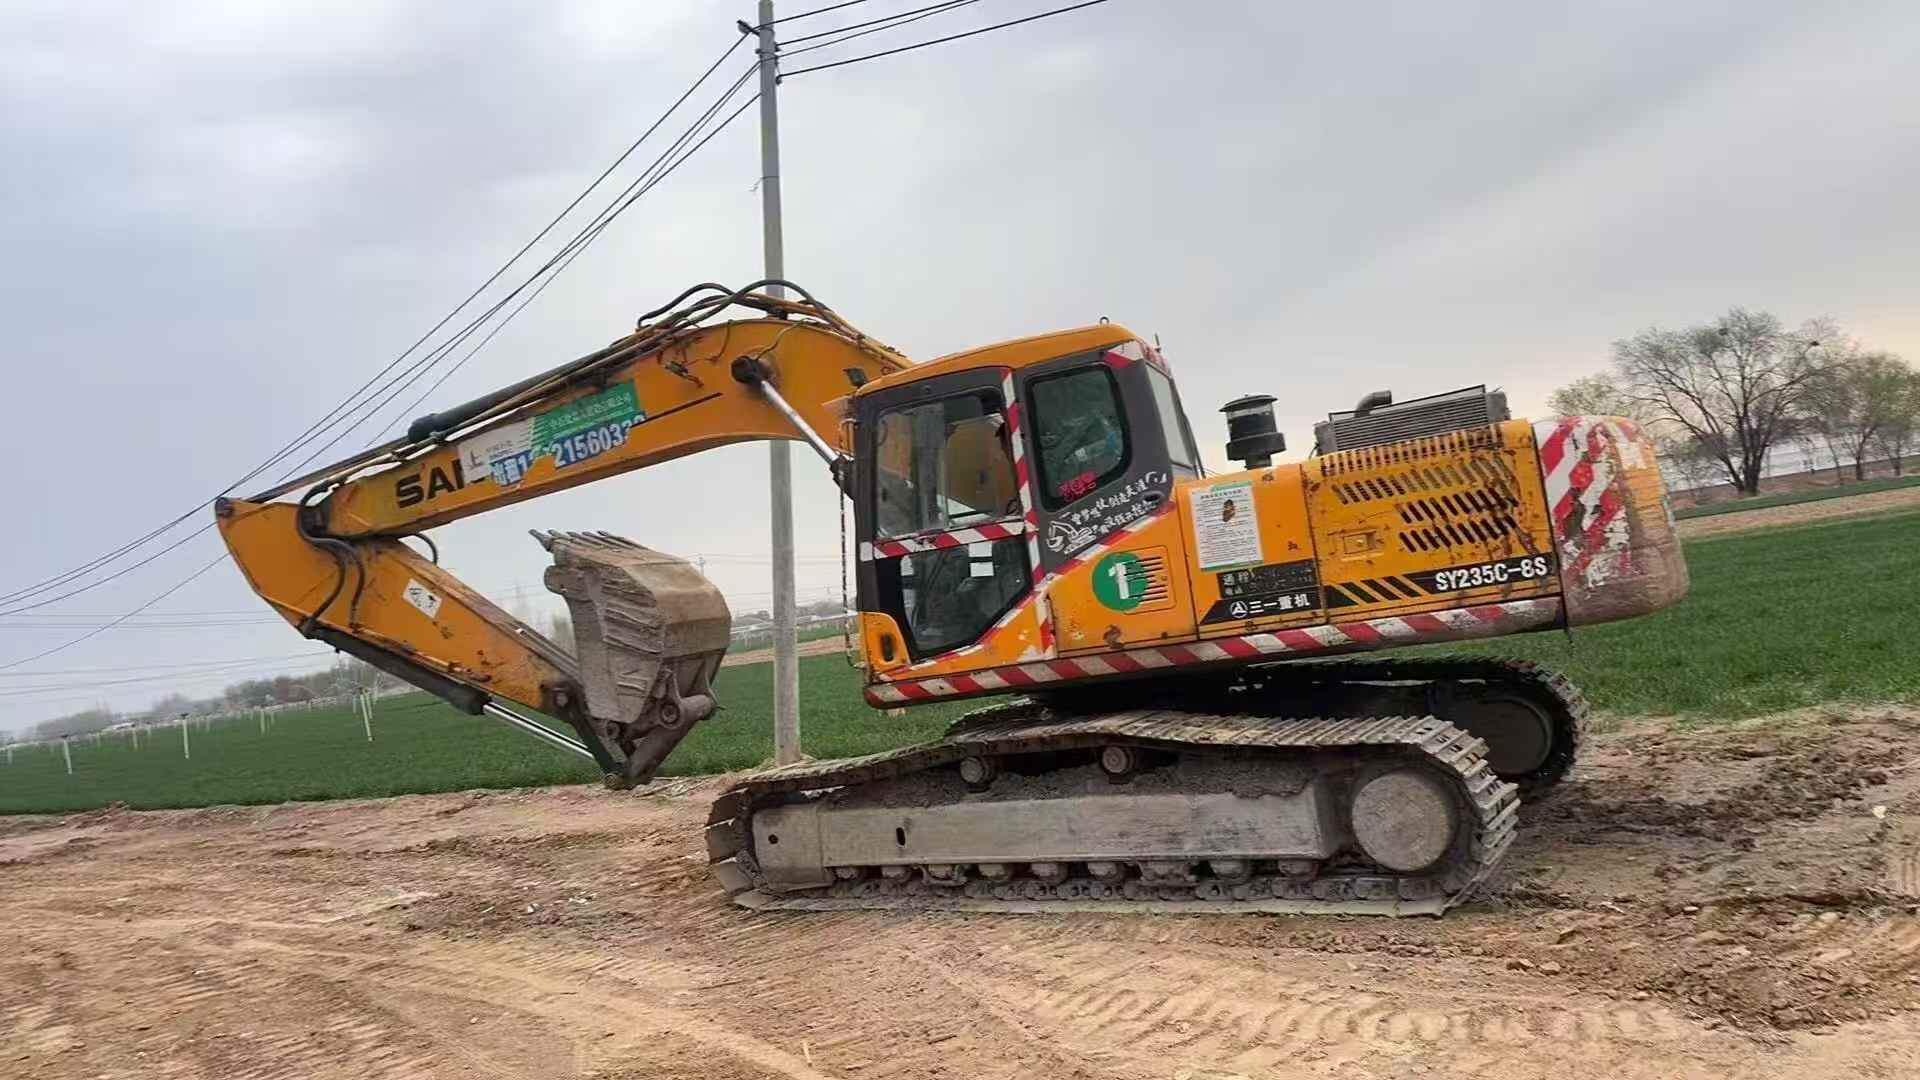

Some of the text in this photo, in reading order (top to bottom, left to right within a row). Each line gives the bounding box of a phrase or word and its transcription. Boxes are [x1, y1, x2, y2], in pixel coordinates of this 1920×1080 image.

[1108, 563, 1130, 600] 1
[1436, 557, 1548, 591] SY235C-8S
[1249, 594, 1310, 613] 三一重机
